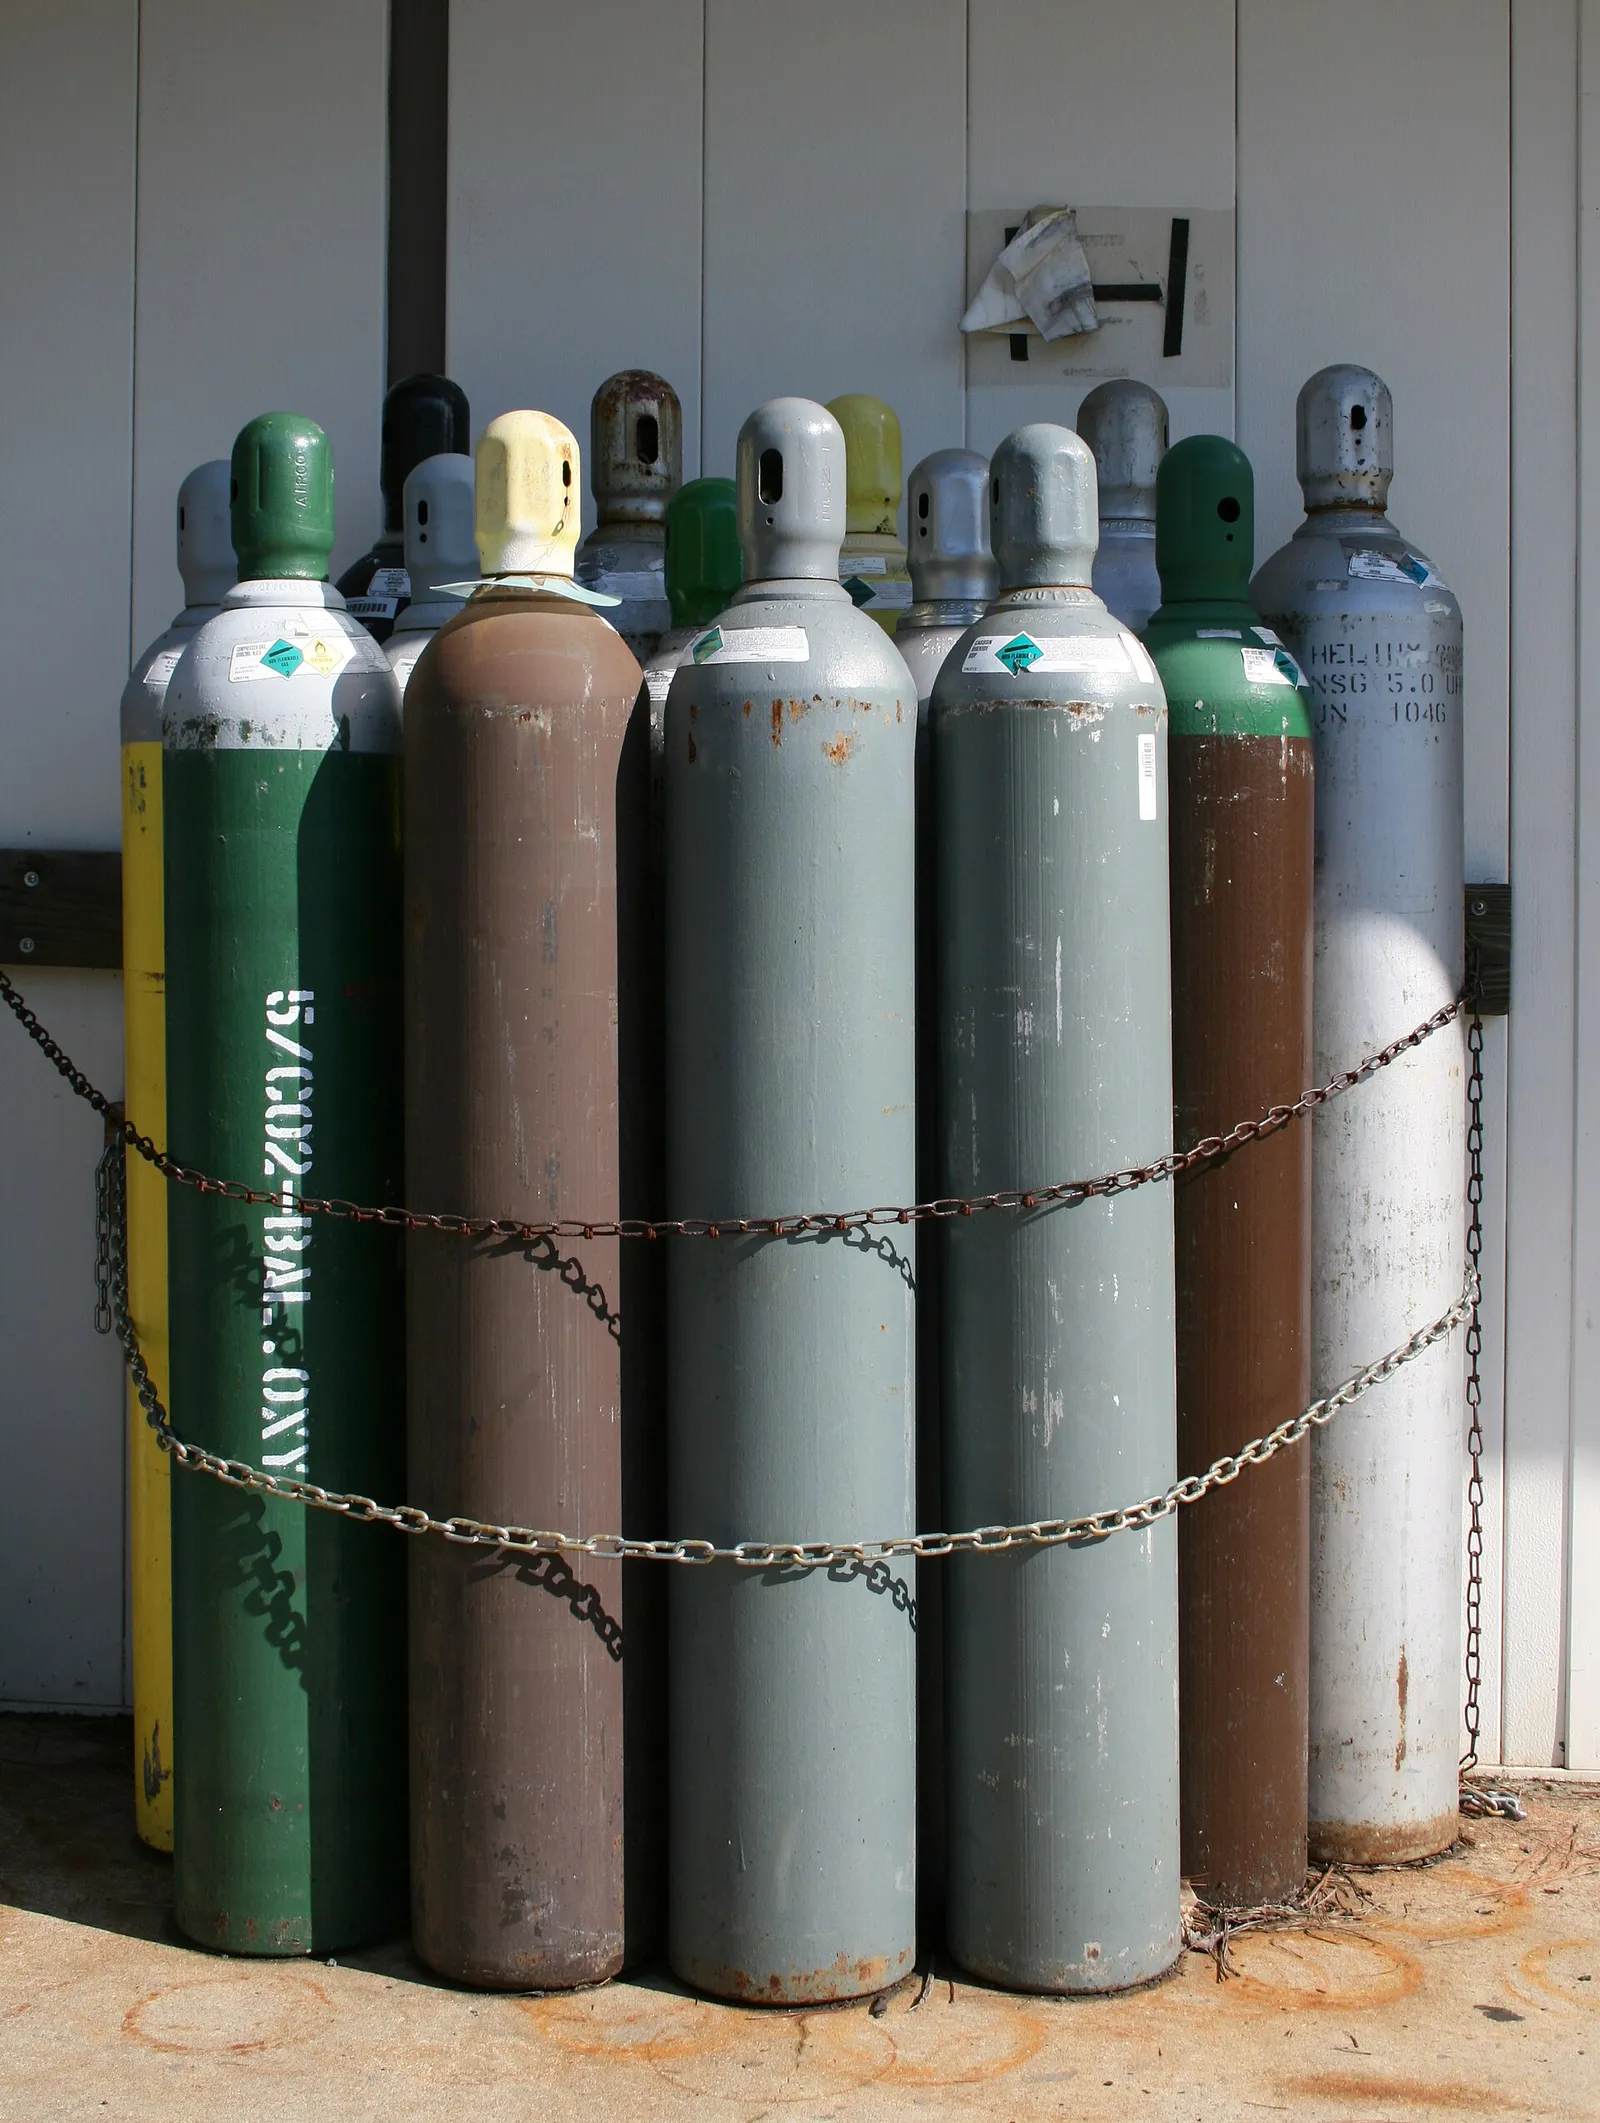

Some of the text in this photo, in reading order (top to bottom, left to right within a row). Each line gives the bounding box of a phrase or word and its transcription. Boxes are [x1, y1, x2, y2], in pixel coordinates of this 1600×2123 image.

[294, 454, 308, 508] AIRCO
[1311, 643, 1421, 667] HELIUM
[1311, 672, 1367, 694] NSG
[1388, 672, 1434, 693] 5.0
[1393, 702, 1446, 723] 1046
